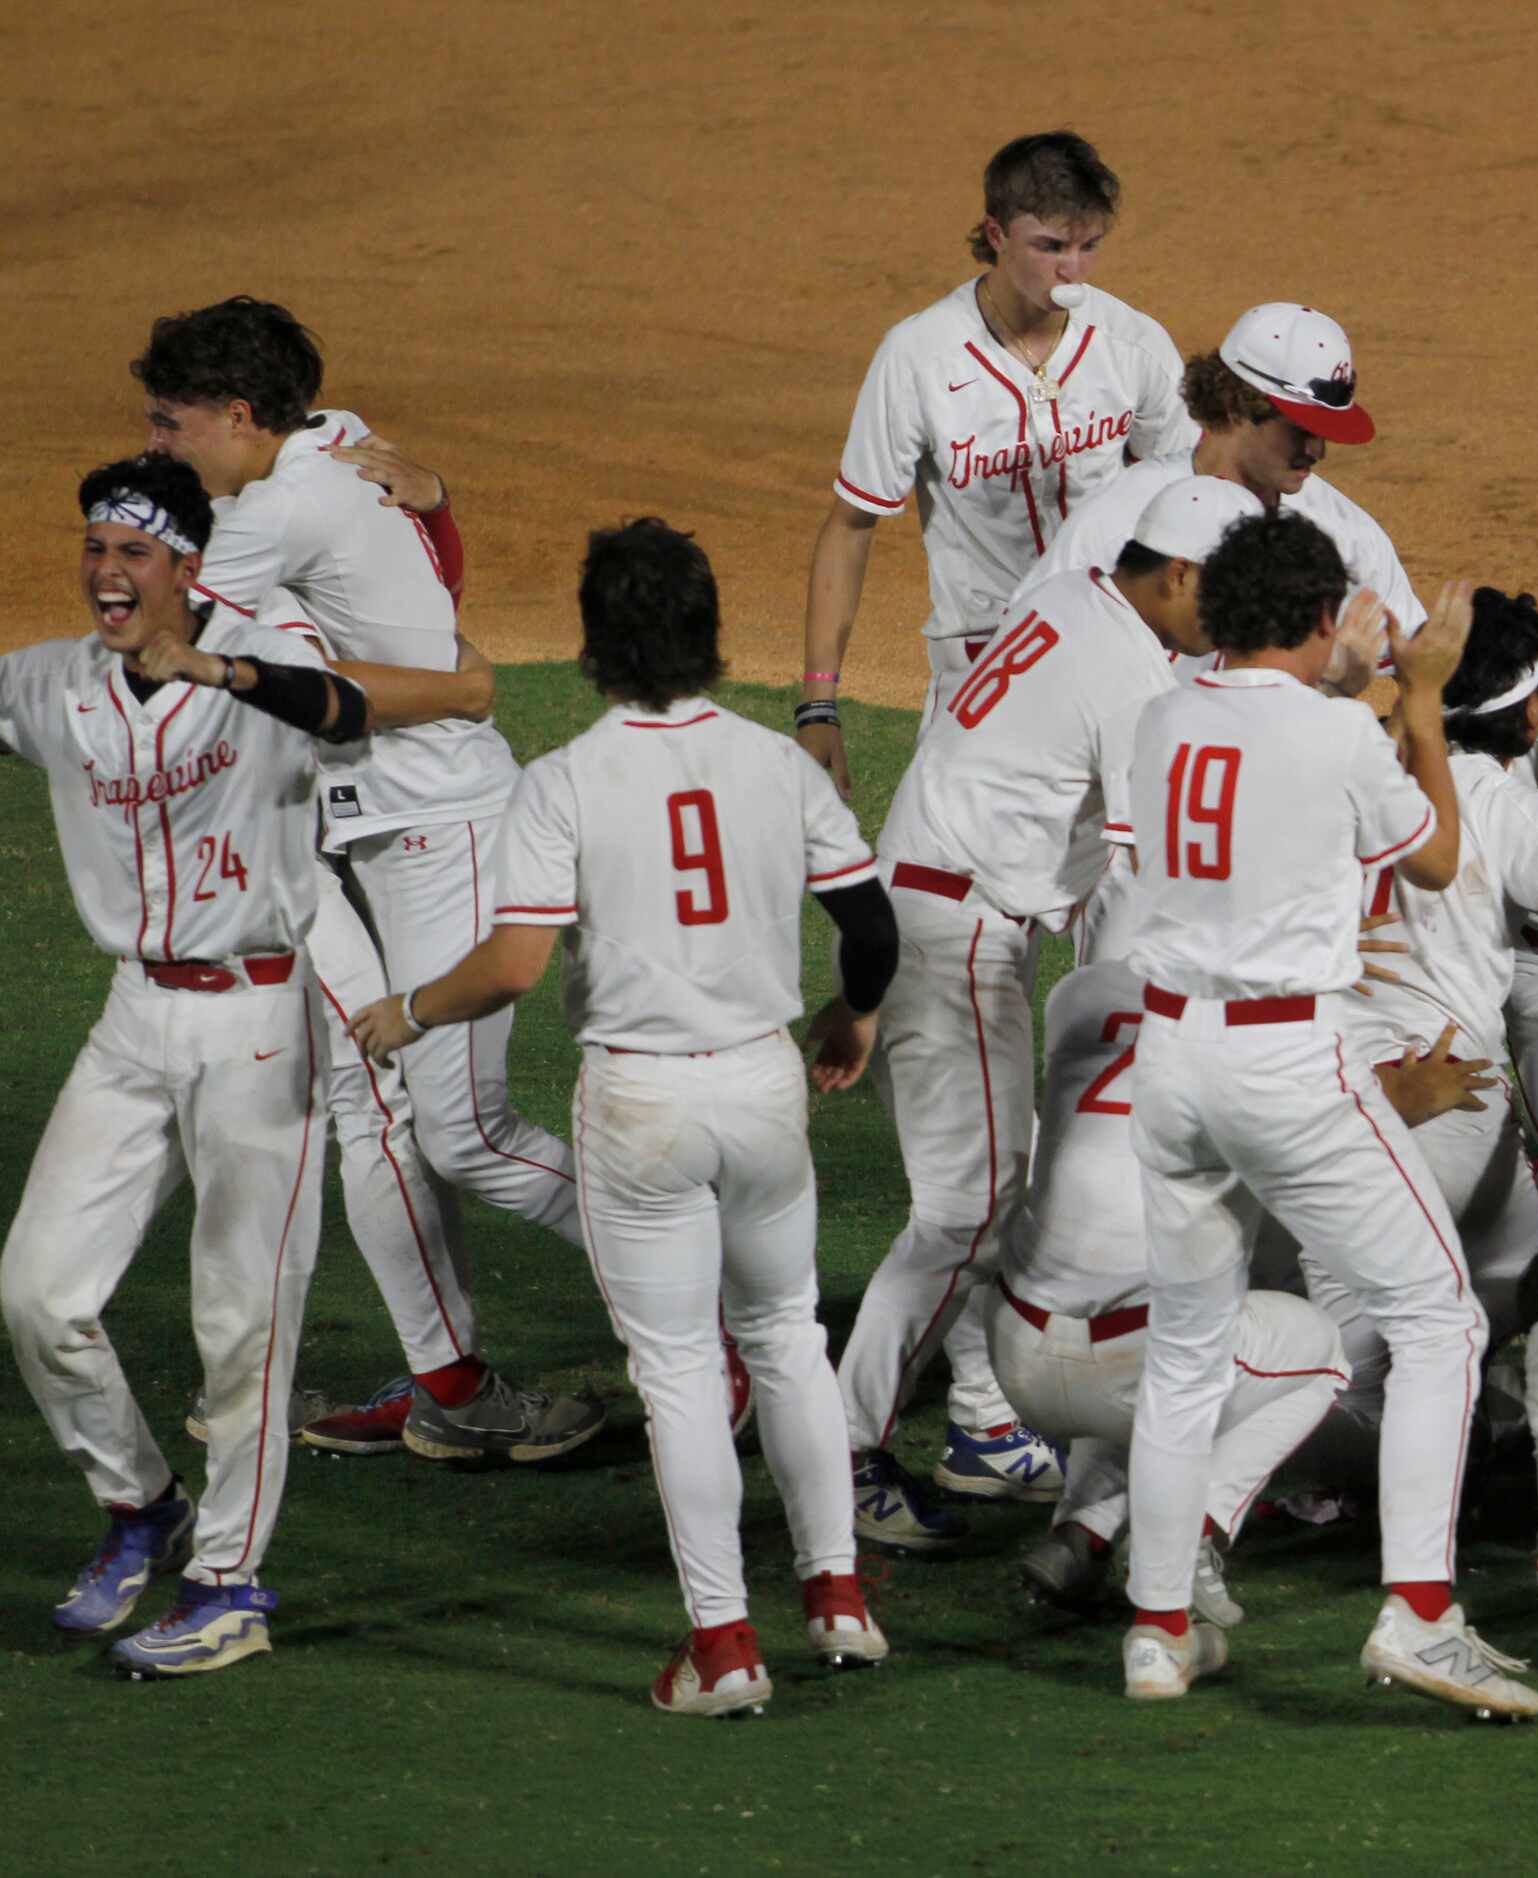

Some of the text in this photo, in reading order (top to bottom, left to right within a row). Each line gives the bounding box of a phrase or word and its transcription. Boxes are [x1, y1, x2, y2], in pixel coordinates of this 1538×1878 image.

[946, 608, 1060, 730] 18
[193, 830, 248, 902] 24
[667, 789, 728, 926] 9
[1165, 742, 1242, 881] 19
